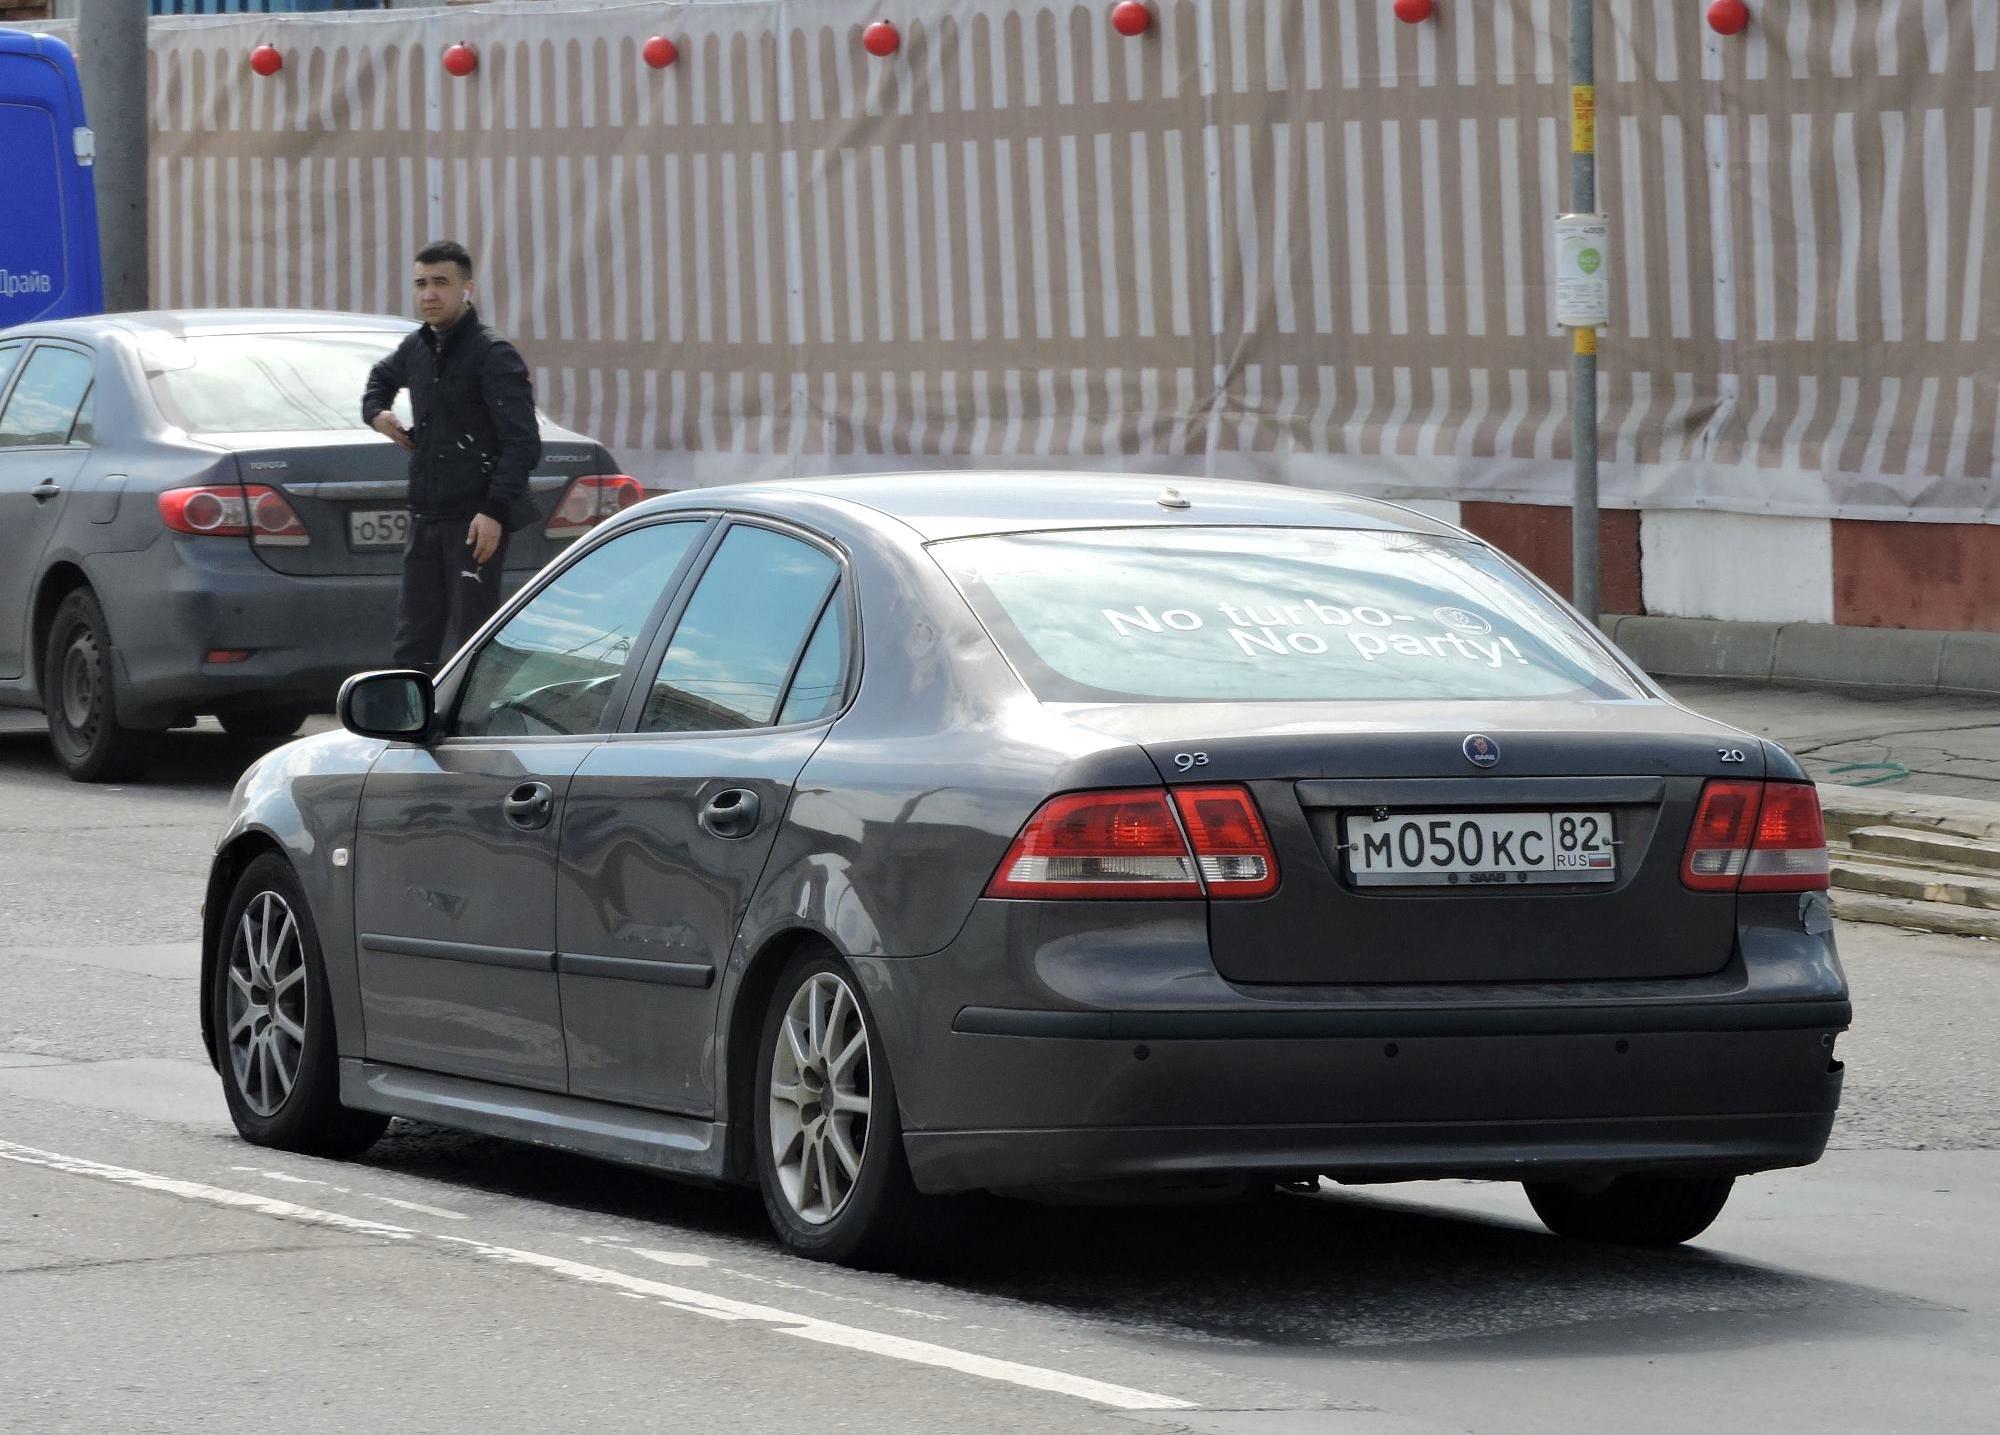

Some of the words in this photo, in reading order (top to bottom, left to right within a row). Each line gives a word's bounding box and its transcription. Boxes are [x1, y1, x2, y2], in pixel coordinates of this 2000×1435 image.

[360, 514, 407, 541] О59
[1101, 605, 1204, 637] No
[1216, 599, 1416, 627] turbo-
[1227, 626, 1329, 657] No
[1346, 632, 1529, 667] party!
[1559, 816, 1600, 852] 82
[1557, 854, 1587, 868] RUS
[1470, 872, 1506, 883] SAAB
